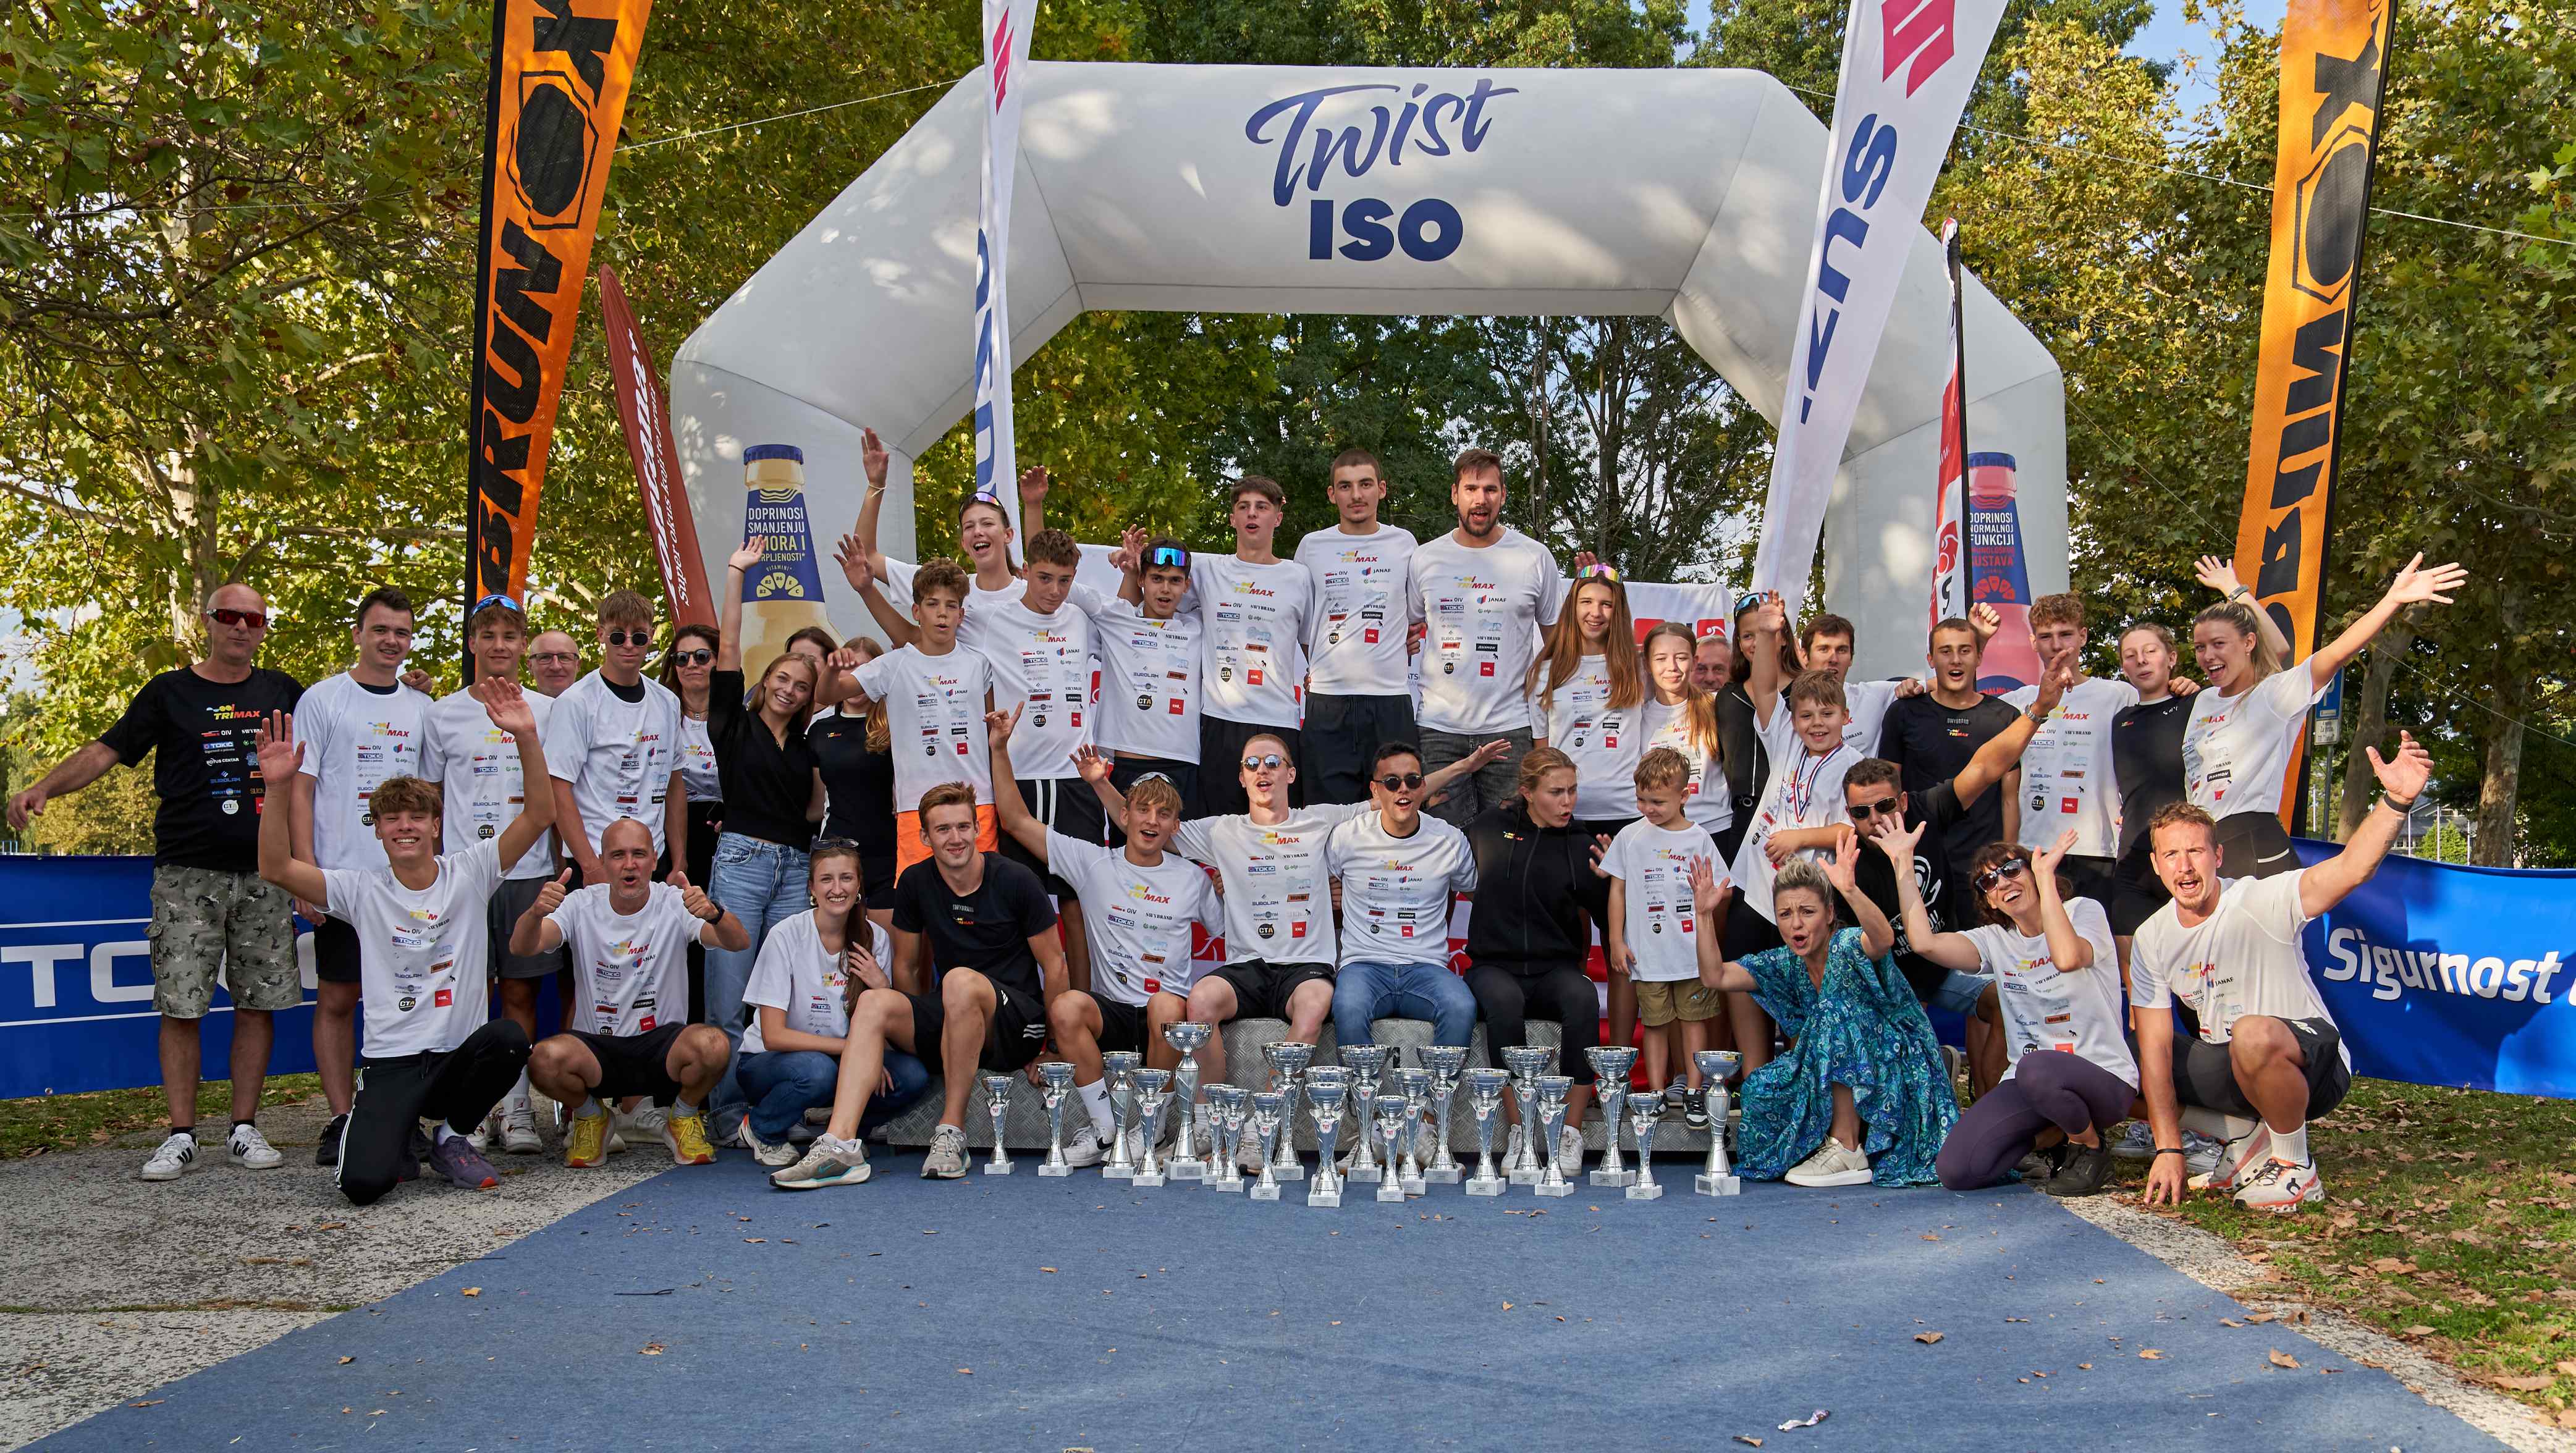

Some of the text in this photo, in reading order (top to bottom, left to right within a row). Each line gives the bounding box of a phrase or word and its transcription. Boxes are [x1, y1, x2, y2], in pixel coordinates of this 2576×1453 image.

[1246, 78, 1519, 206] Twist
[1309, 198, 1463, 262] ISO
[1800, 113, 1897, 426] SUZ
[748, 507, 803, 520] DOPRINOSI
[748, 521, 805, 533] SMANJENJU
[1235, 588, 1275, 597] TRIMAX
[214, 711, 261, 720] TRIMAX
[373, 730, 410, 738] TRIMAX
[2323, 927, 2562, 1004] Sigurnost
[2215, 977, 2234, 986] JANAF
